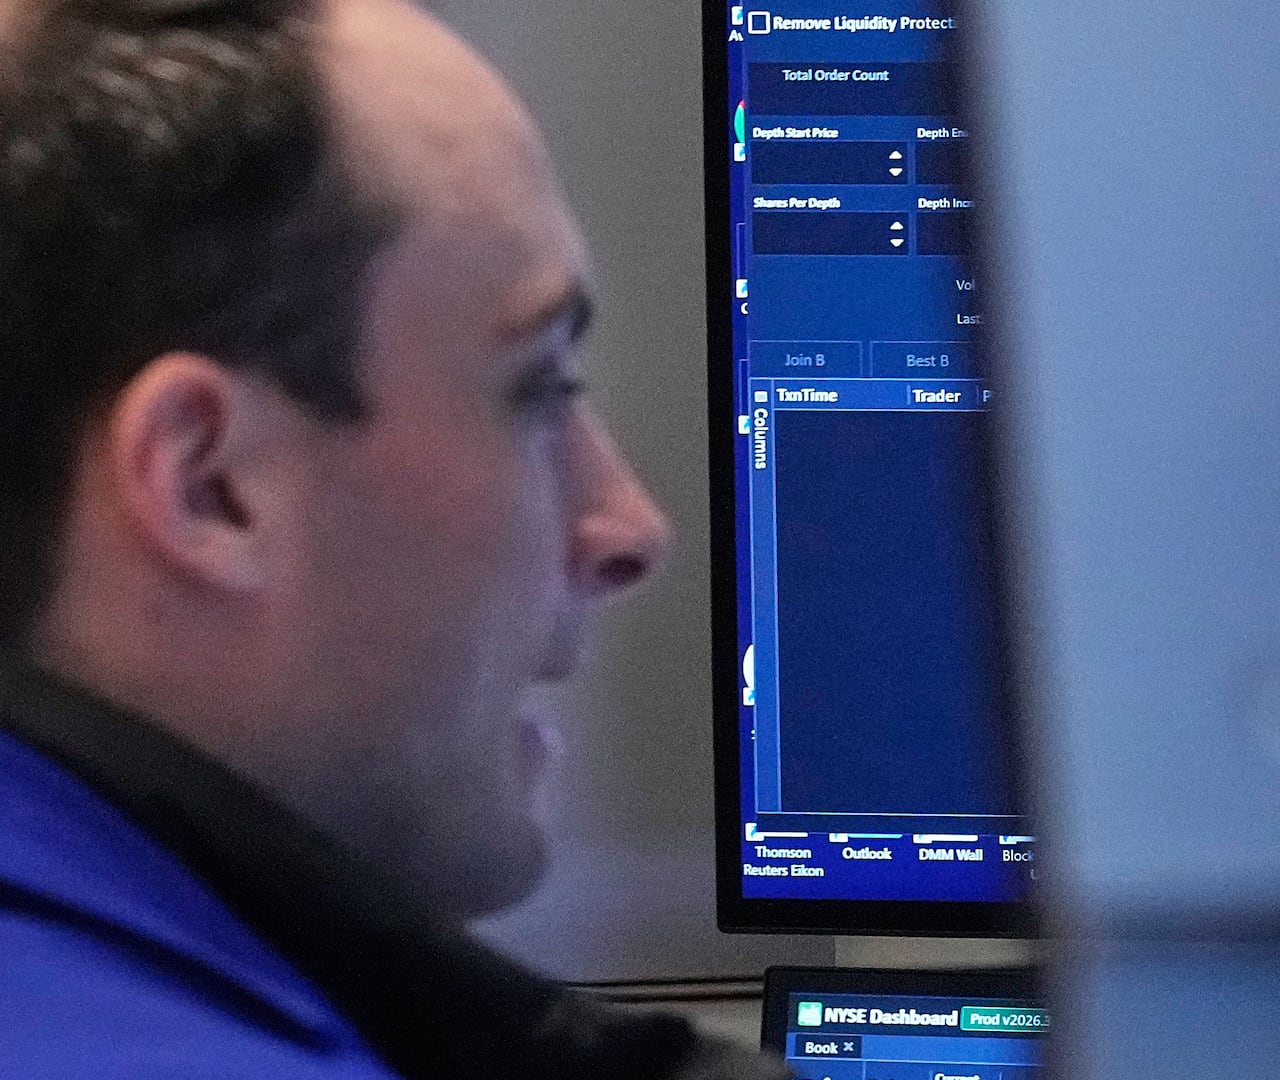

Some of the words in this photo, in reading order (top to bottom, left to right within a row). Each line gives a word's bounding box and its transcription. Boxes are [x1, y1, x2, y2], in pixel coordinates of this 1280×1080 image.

[773, 16, 831, 31] Remove
[834, 16, 897, 33] Liquidity
[782, 70, 812, 82] Total
[815, 70, 849, 82] Order
[852, 70, 889, 82] Count
[752, 128, 784, 141] Depth
[785, 128, 811, 139] Start
[812, 128, 839, 139] Price
[917, 128, 949, 140] Depth
[753, 197, 788, 209] Shares
[789, 197, 807, 209] Per
[808, 197, 841, 210] Depth
[917, 198, 950, 210] Depth
[785, 353, 812, 367] Join
[816, 354, 825, 366] B
[907, 354, 936, 368] Best
[940, 355, 950, 367] B
[776, 388, 838, 403] TxnTime
[912, 389, 961, 403] Trader
[753, 408, 768, 470] Columns
[754, 846, 812, 859] Thomson
[842, 847, 892, 860] Outlook
[919, 848, 954, 861] DMM
[956, 848, 984, 861] Wall
[743, 864, 788, 877] Reuters
[790, 865, 824, 877] Eikon
[824, 1007, 867, 1023] NYSE
[869, 1008, 959, 1026] Dashboard
[970, 1013, 1000, 1025] Prod
[805, 1040, 838, 1054] Book
